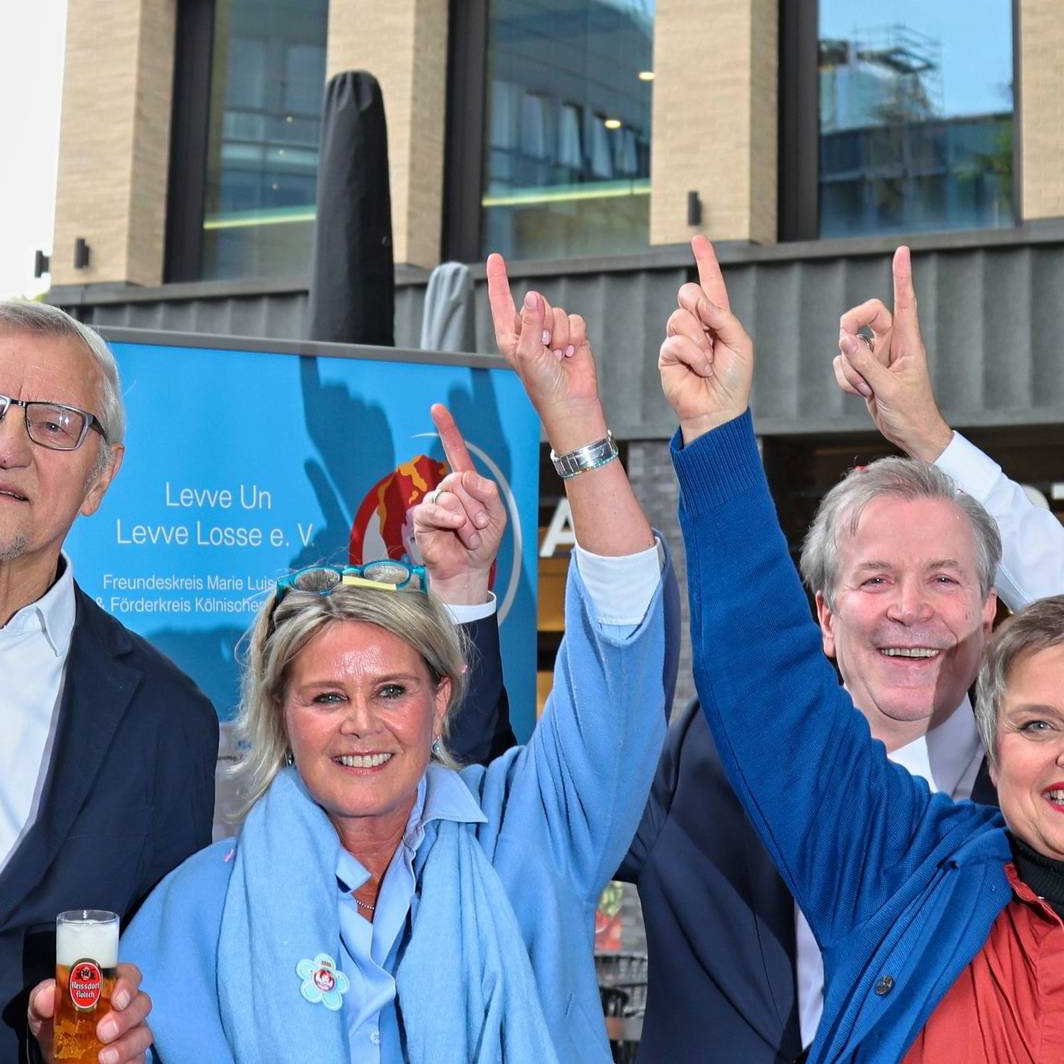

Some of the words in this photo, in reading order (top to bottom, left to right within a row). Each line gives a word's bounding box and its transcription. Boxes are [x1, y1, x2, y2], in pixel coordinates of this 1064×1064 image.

[165, 482, 232, 508] Levve
[240, 484, 272, 510] Un
[116, 519, 189, 545] Levve
[197, 520, 262, 546] Losse
[270, 528, 289, 547] e.
[297, 522, 315, 548] V.
[103, 574, 203, 591] Freundeskreis
[207, 575, 244, 591] Marie
[247, 576, 277, 592] Luis
[110, 597, 191, 613] Förderkreis
